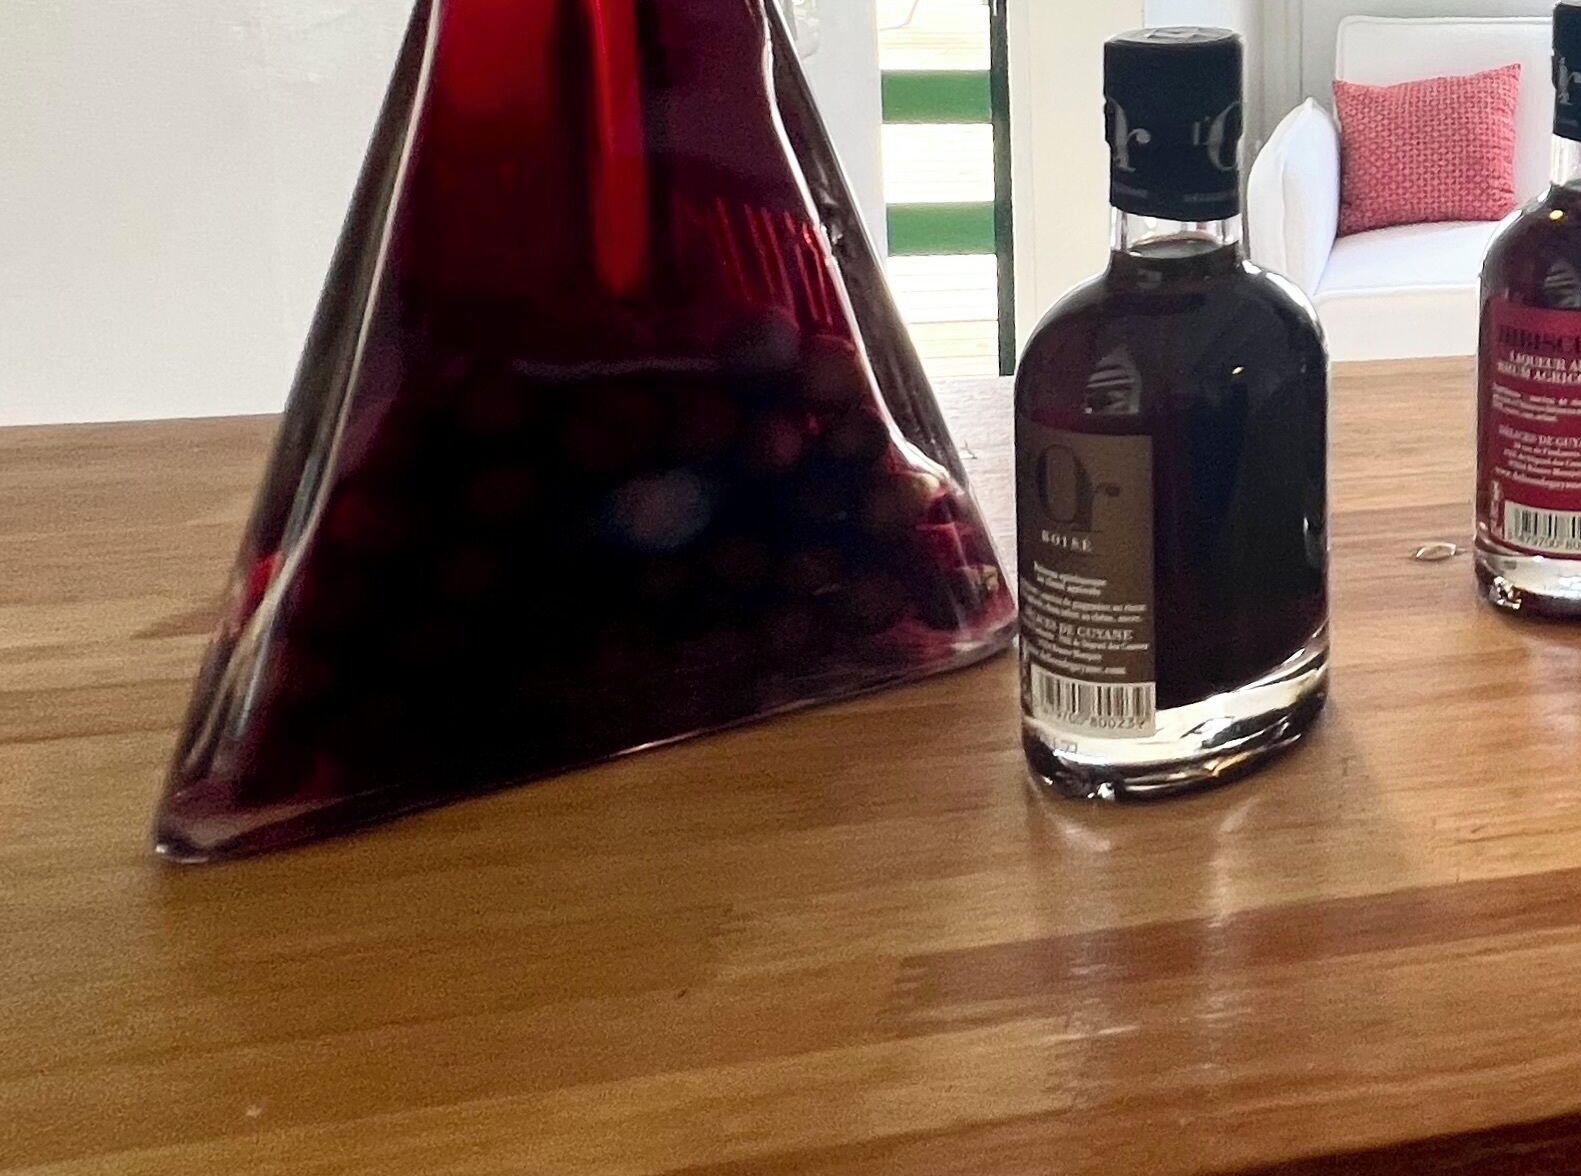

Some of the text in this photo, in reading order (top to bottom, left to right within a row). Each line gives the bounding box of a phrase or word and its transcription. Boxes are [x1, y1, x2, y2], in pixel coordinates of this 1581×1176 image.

[1509, 349, 1567, 371] LIQUEUR
[1058, 623, 1077, 639] DE
[1077, 625, 1134, 642] GUYANE
